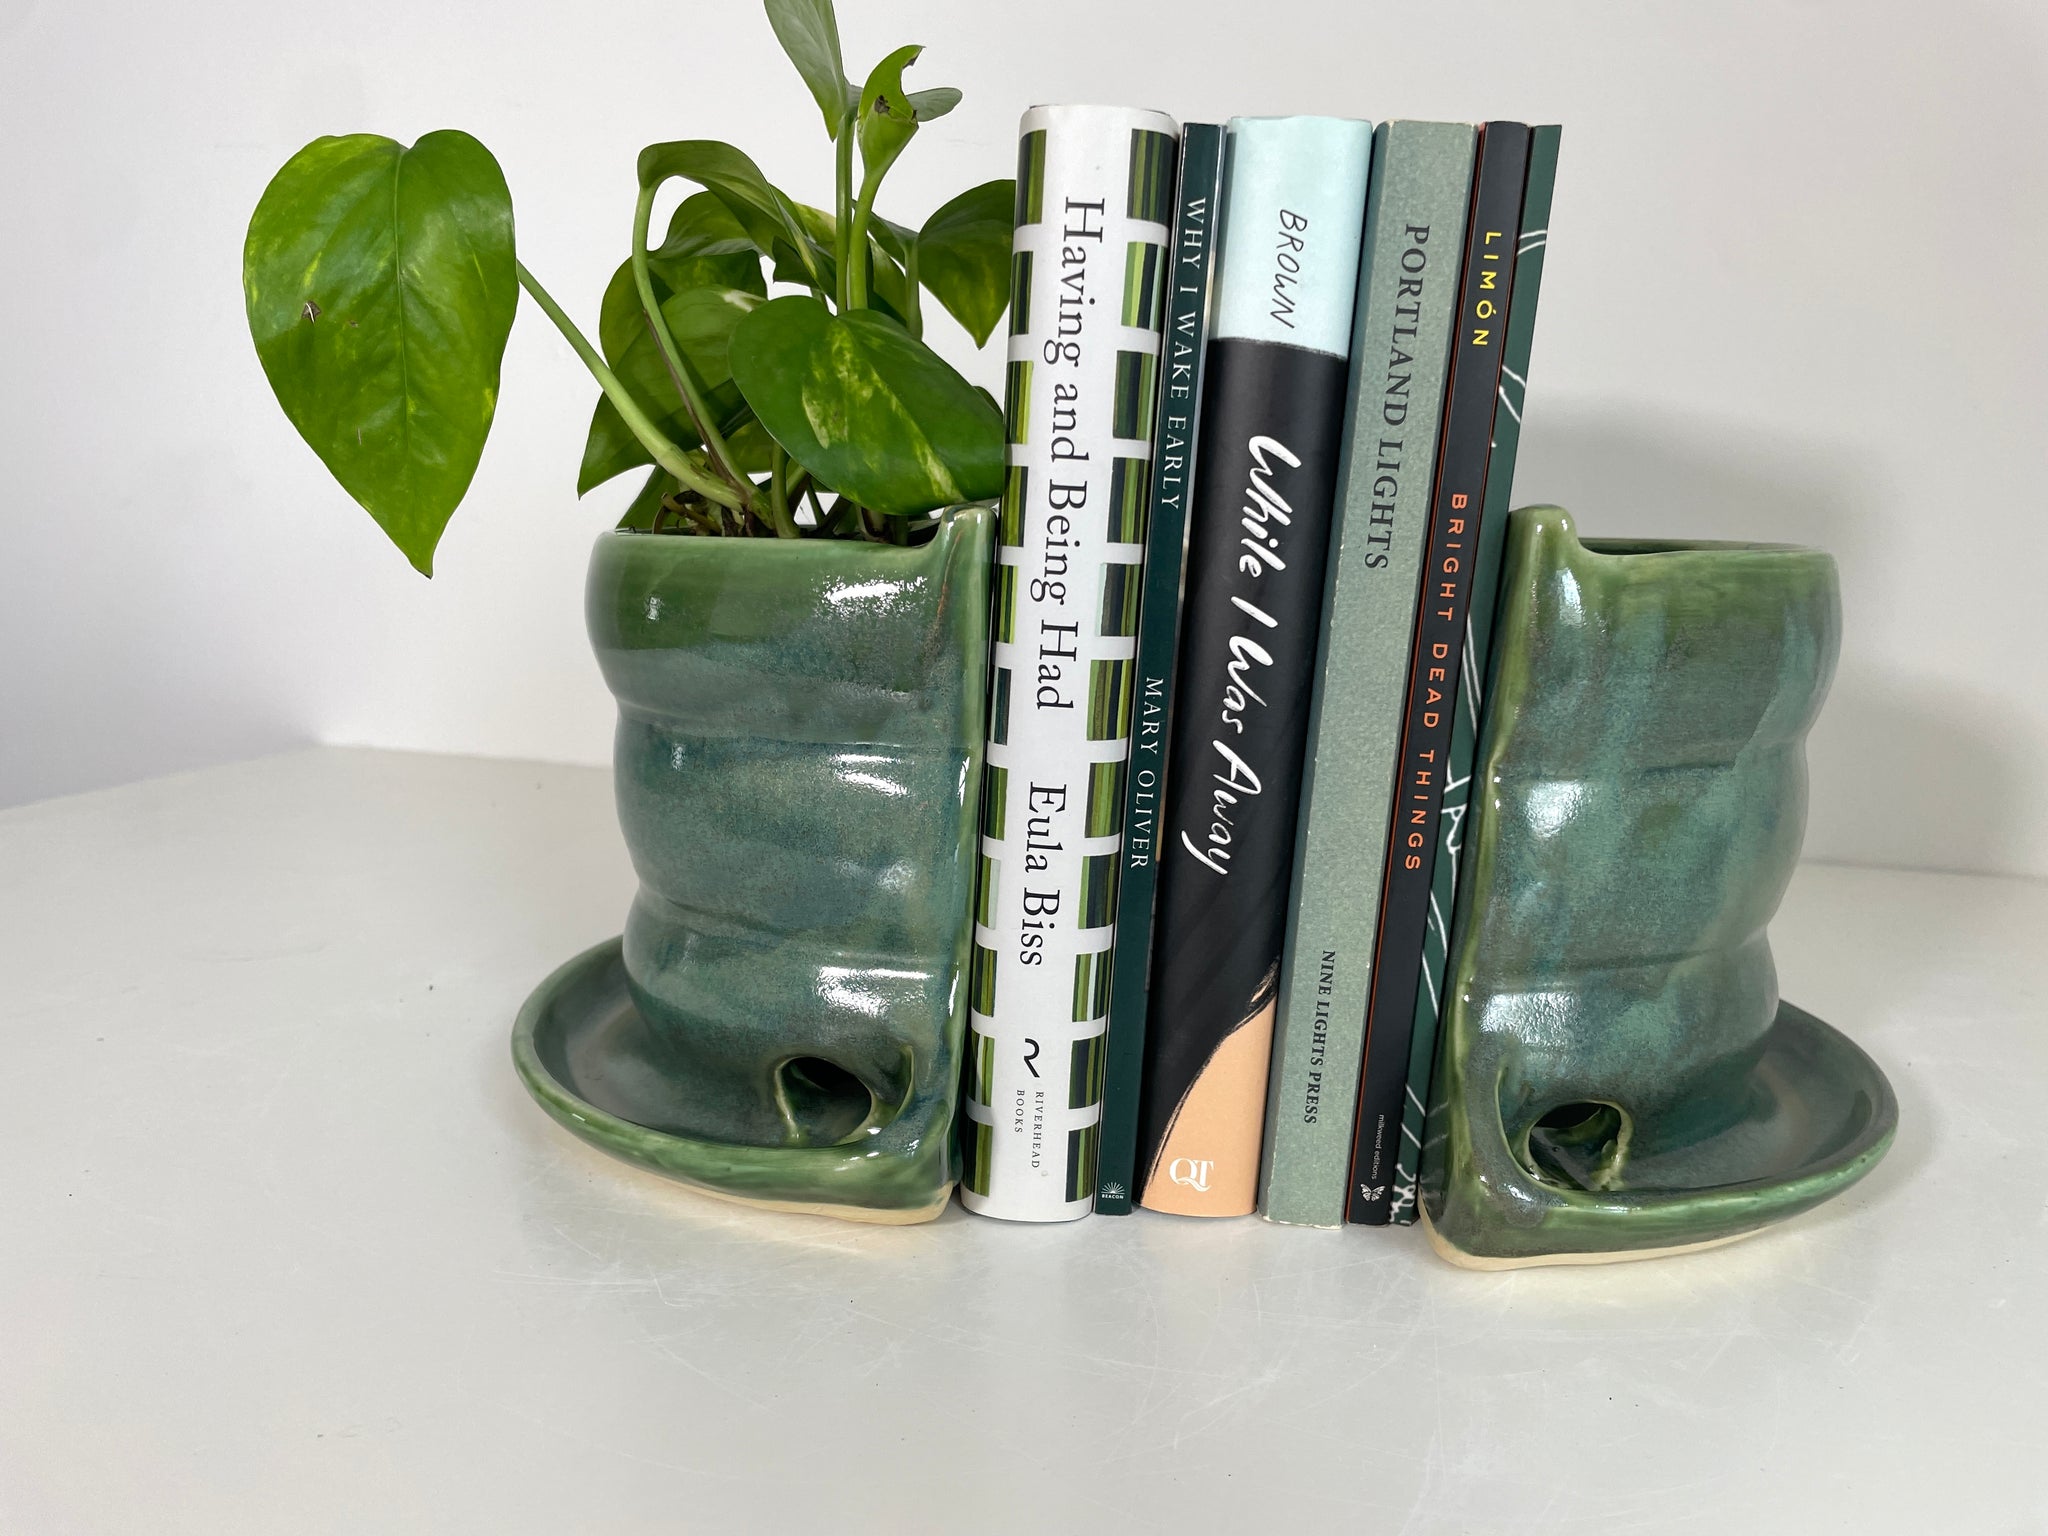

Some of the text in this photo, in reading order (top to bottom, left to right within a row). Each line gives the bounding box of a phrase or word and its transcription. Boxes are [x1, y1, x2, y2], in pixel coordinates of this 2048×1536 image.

[1161, 198, 1206, 509] WHY I WAKE EARLY
[1270, 209, 1308, 328] BROWN
[1472, 231, 1502, 346] LIMÓN
[1030, 197, 1105, 709] Having and Being Had
[1365, 224, 1430, 569] PORTLAND LIGHTS
[1182, 435, 1302, 875] While I Was Away
[1405, 494, 1467, 869] BRIGHT DEAD THINGS
[1131, 677, 1163, 868] MARY OLIVER
[1020, 781, 1066, 966] Eula Biss
[1015, 1089, 1025, 1133] BOOKS
[1304, 950, 1335, 1125] NINE LIGHTS PRESS
[1032, 1090, 1044, 1168] RIVERHEAD
[1169, 1157, 1214, 1192] QT
[1370, 1114, 1384, 1180] milkweed editions
